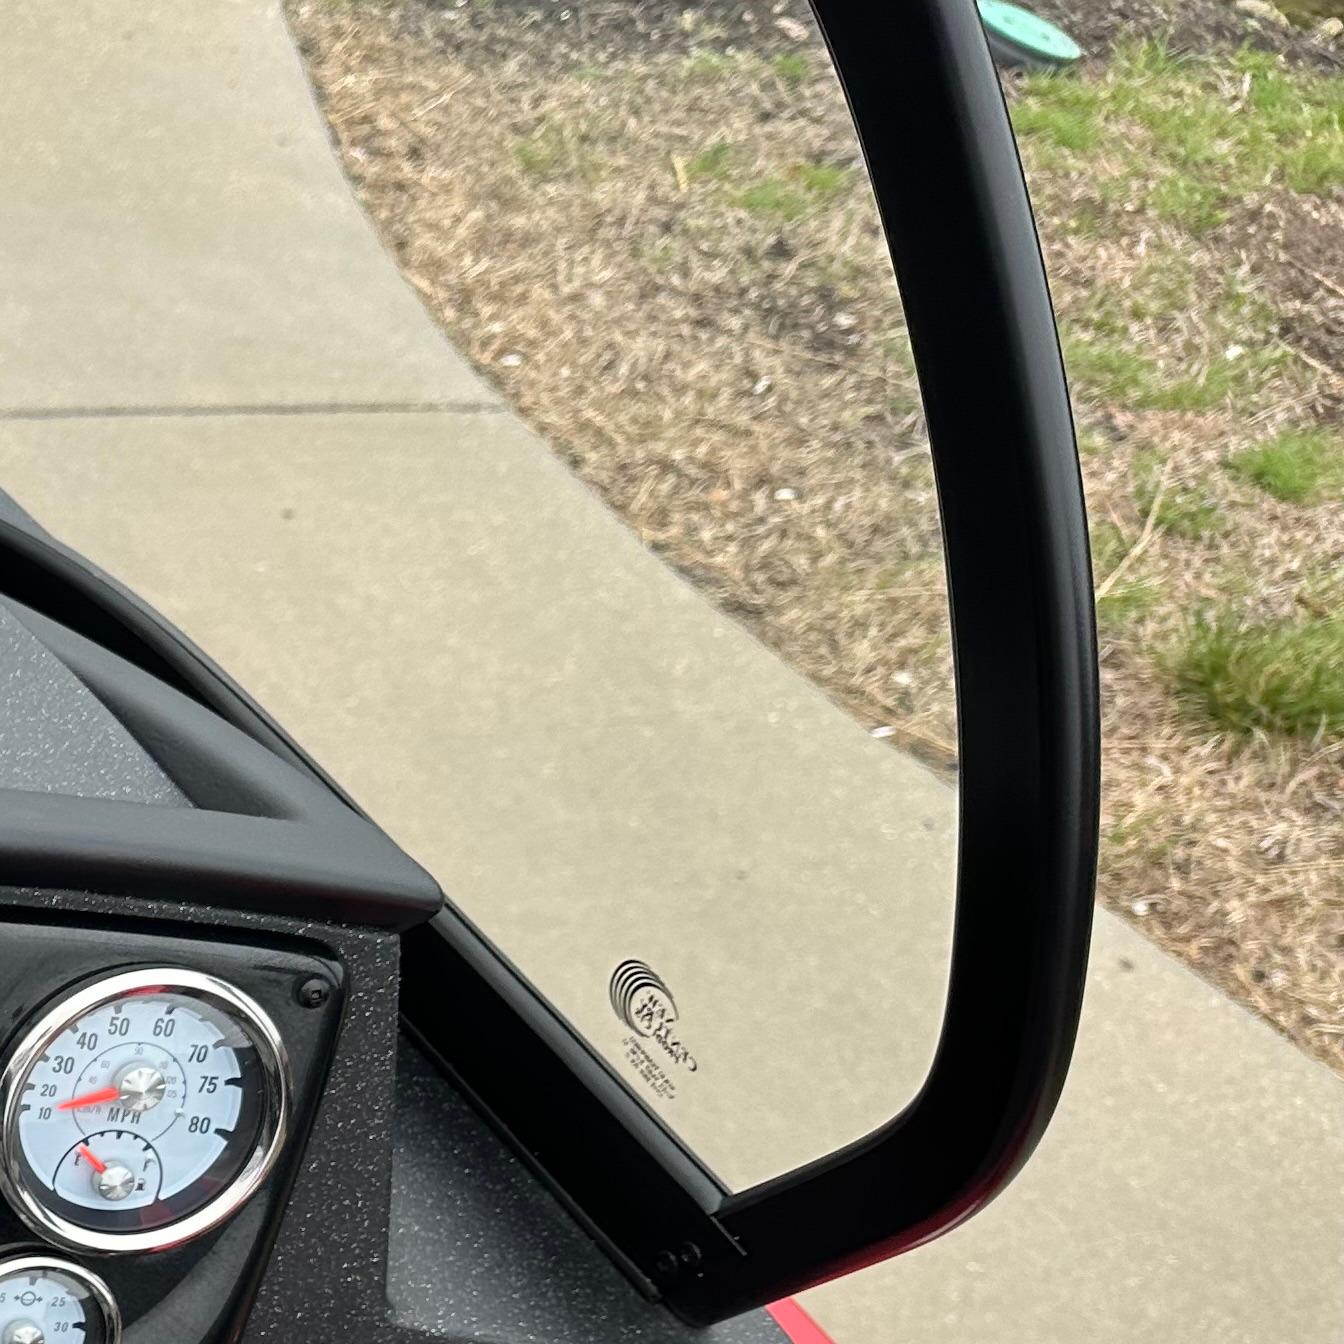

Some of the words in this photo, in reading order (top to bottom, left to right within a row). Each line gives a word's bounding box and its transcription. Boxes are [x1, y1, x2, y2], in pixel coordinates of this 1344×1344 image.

[108, 1016, 130, 1037] 50
[152, 1018, 176, 1037] 60
[76, 1032, 98, 1051] 40
[188, 1044, 209, 1063] 70
[52, 1056, 74, 1074] 30
[40, 1083, 57, 1097] 20
[198, 1076, 219, 1094] 75
[38, 1107, 52, 1120] 10
[107, 1109, 141, 1125] MPH
[188, 1117, 211, 1134] 80
[51, 1296, 66, 1308] 25
[54, 1322, 69, 1332] 30
